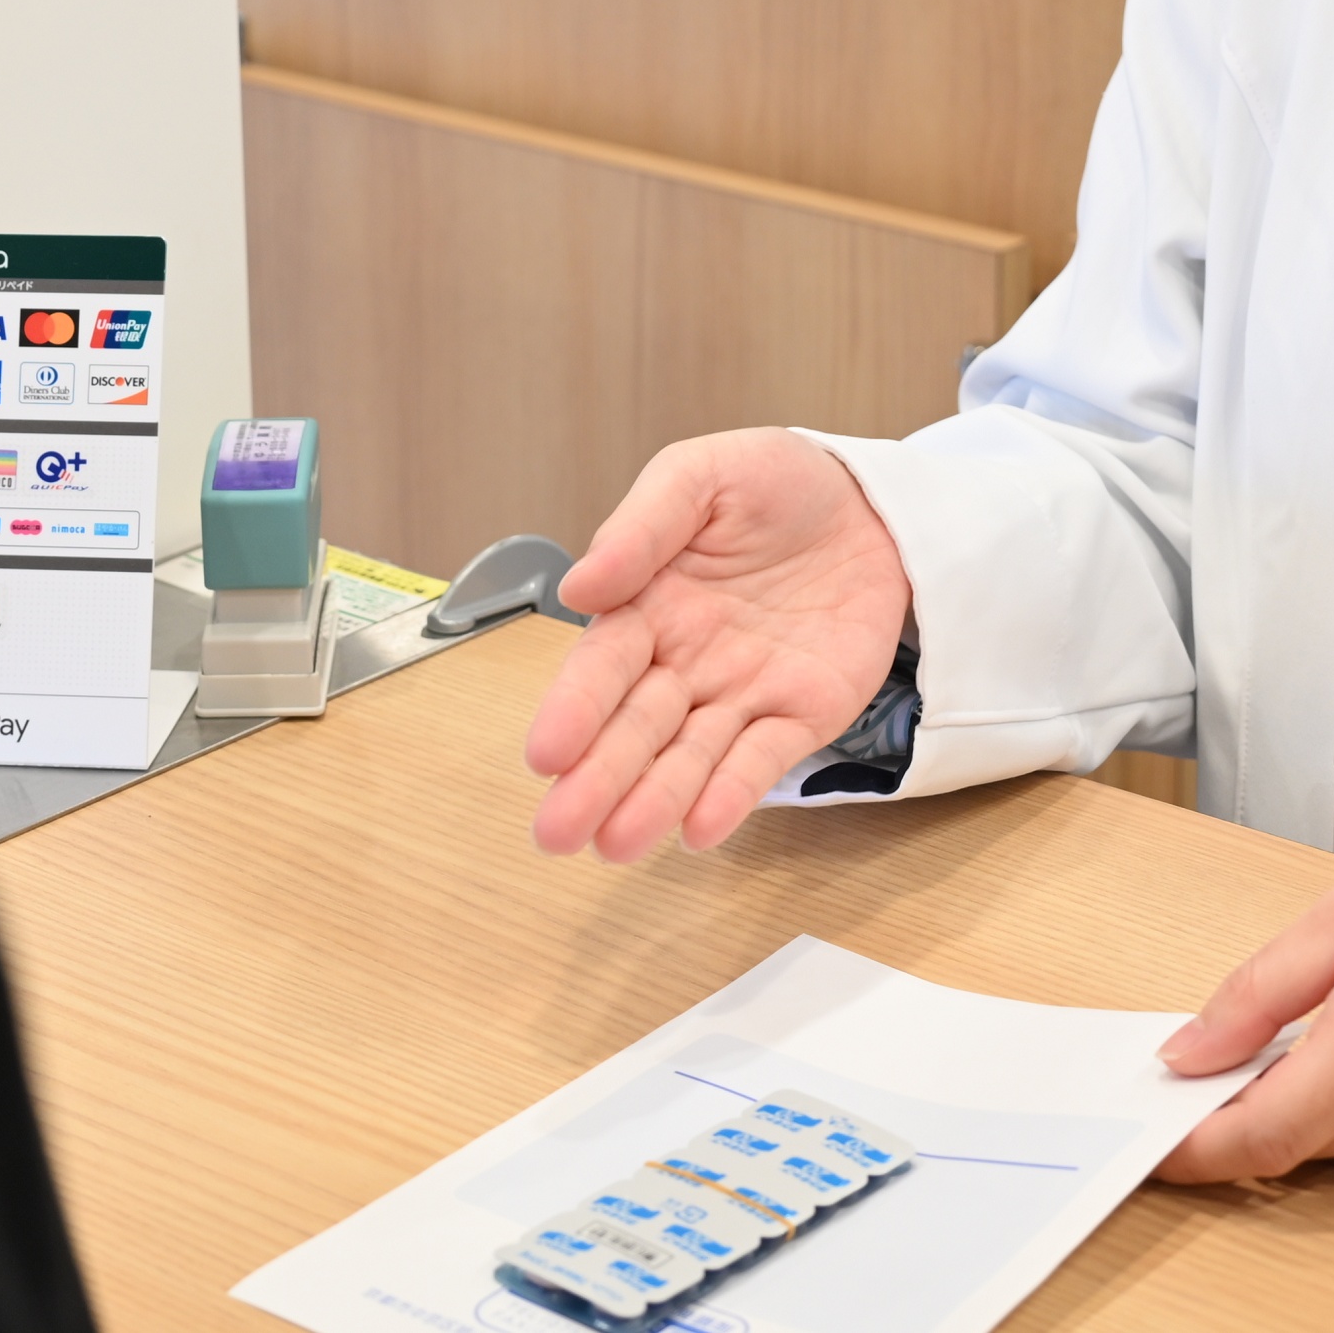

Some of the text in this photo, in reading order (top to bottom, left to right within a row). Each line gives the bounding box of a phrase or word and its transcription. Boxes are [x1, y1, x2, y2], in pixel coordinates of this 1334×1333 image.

[96, 319, 147, 333] UnionPay
[91, 376, 146, 387] DISCOVER
[23, 385, 70, 395] Diners Club
[51, 524, 86, 534] nimoca
